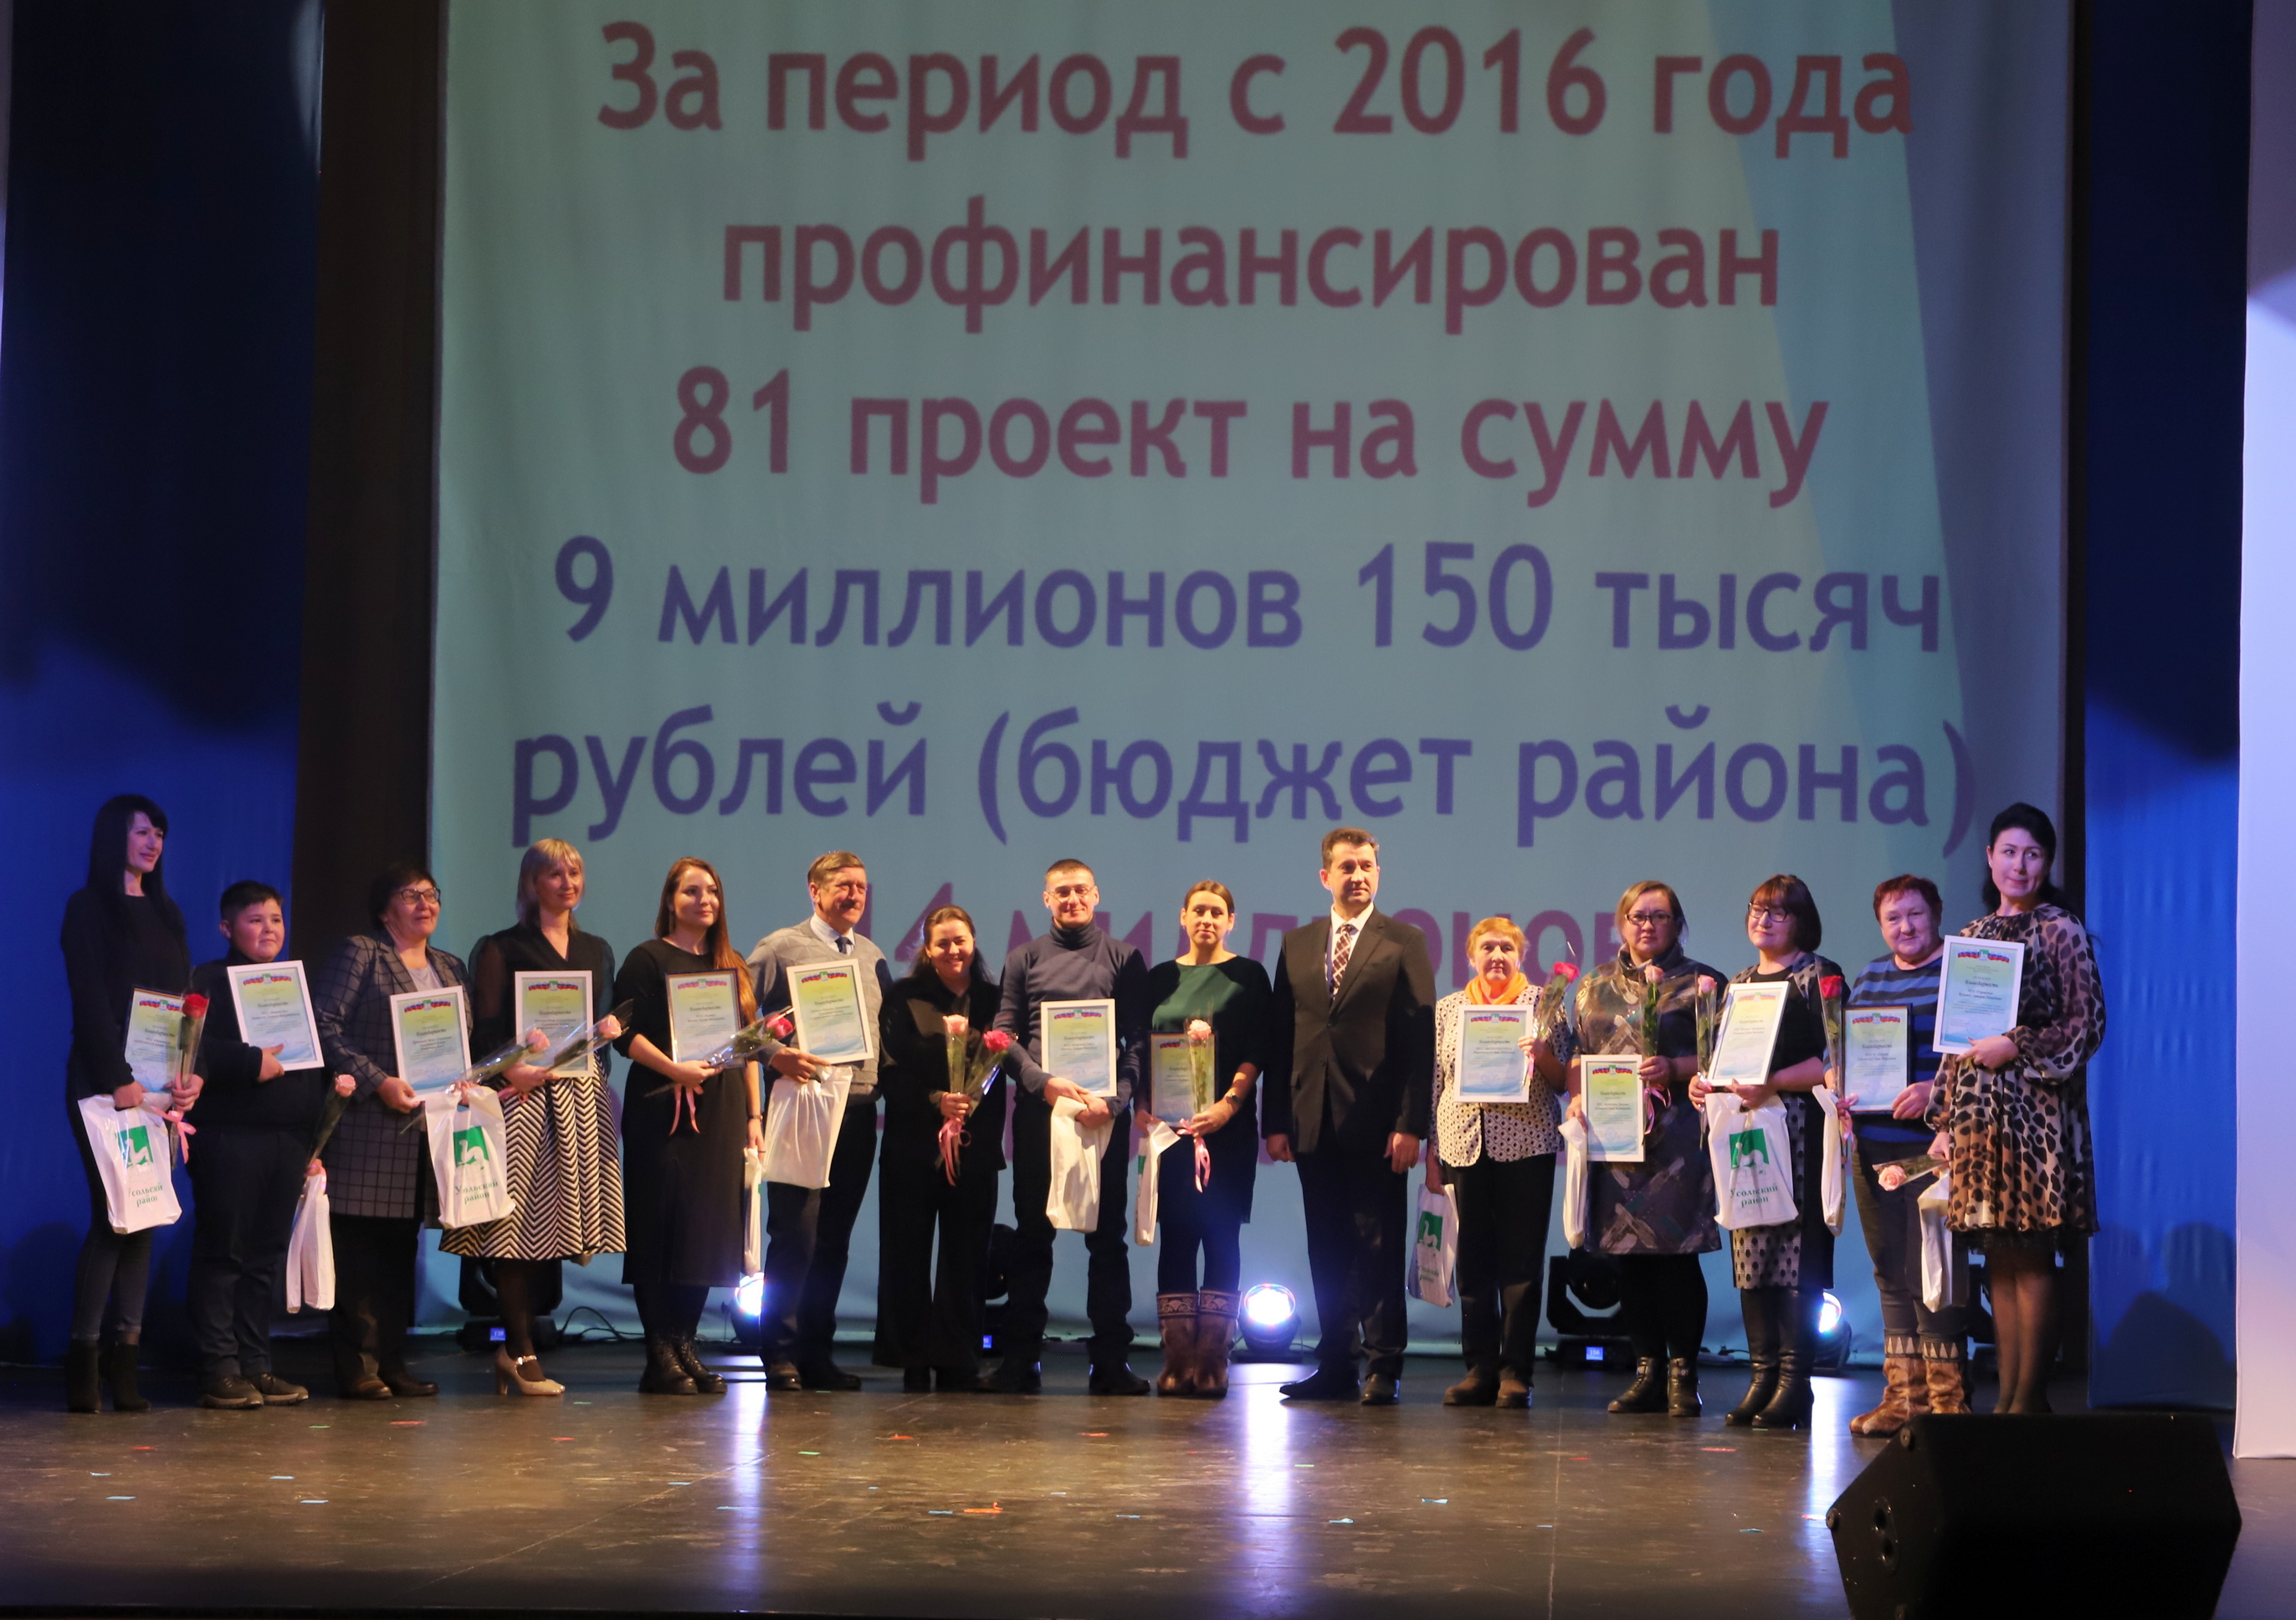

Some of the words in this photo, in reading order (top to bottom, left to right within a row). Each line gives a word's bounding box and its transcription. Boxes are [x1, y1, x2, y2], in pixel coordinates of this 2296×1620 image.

[597, 20, 724, 131] За
[766, 52, 1190, 162] период
[1228, 53, 1288, 136] с
[1332, 25, 1607, 136] 2016
[1653, 50, 1913, 159] года
[722, 194, 1781, 336] профинансирован
[672, 365, 791, 475] 81
[848, 397, 1248, 505] проект
[1290, 398, 1419, 479] на
[1459, 397, 1830, 509] сумму
[553, 535, 615, 643] 9
[658, 566, 1303, 649] миллионов
[1357, 541, 1555, 652] 150
[1593, 572, 1942, 654] тысяч
[510, 700, 928, 846] рублей
[976, 706, 1473, 845] (бюджет
[1515, 705, 1981, 859] района)
